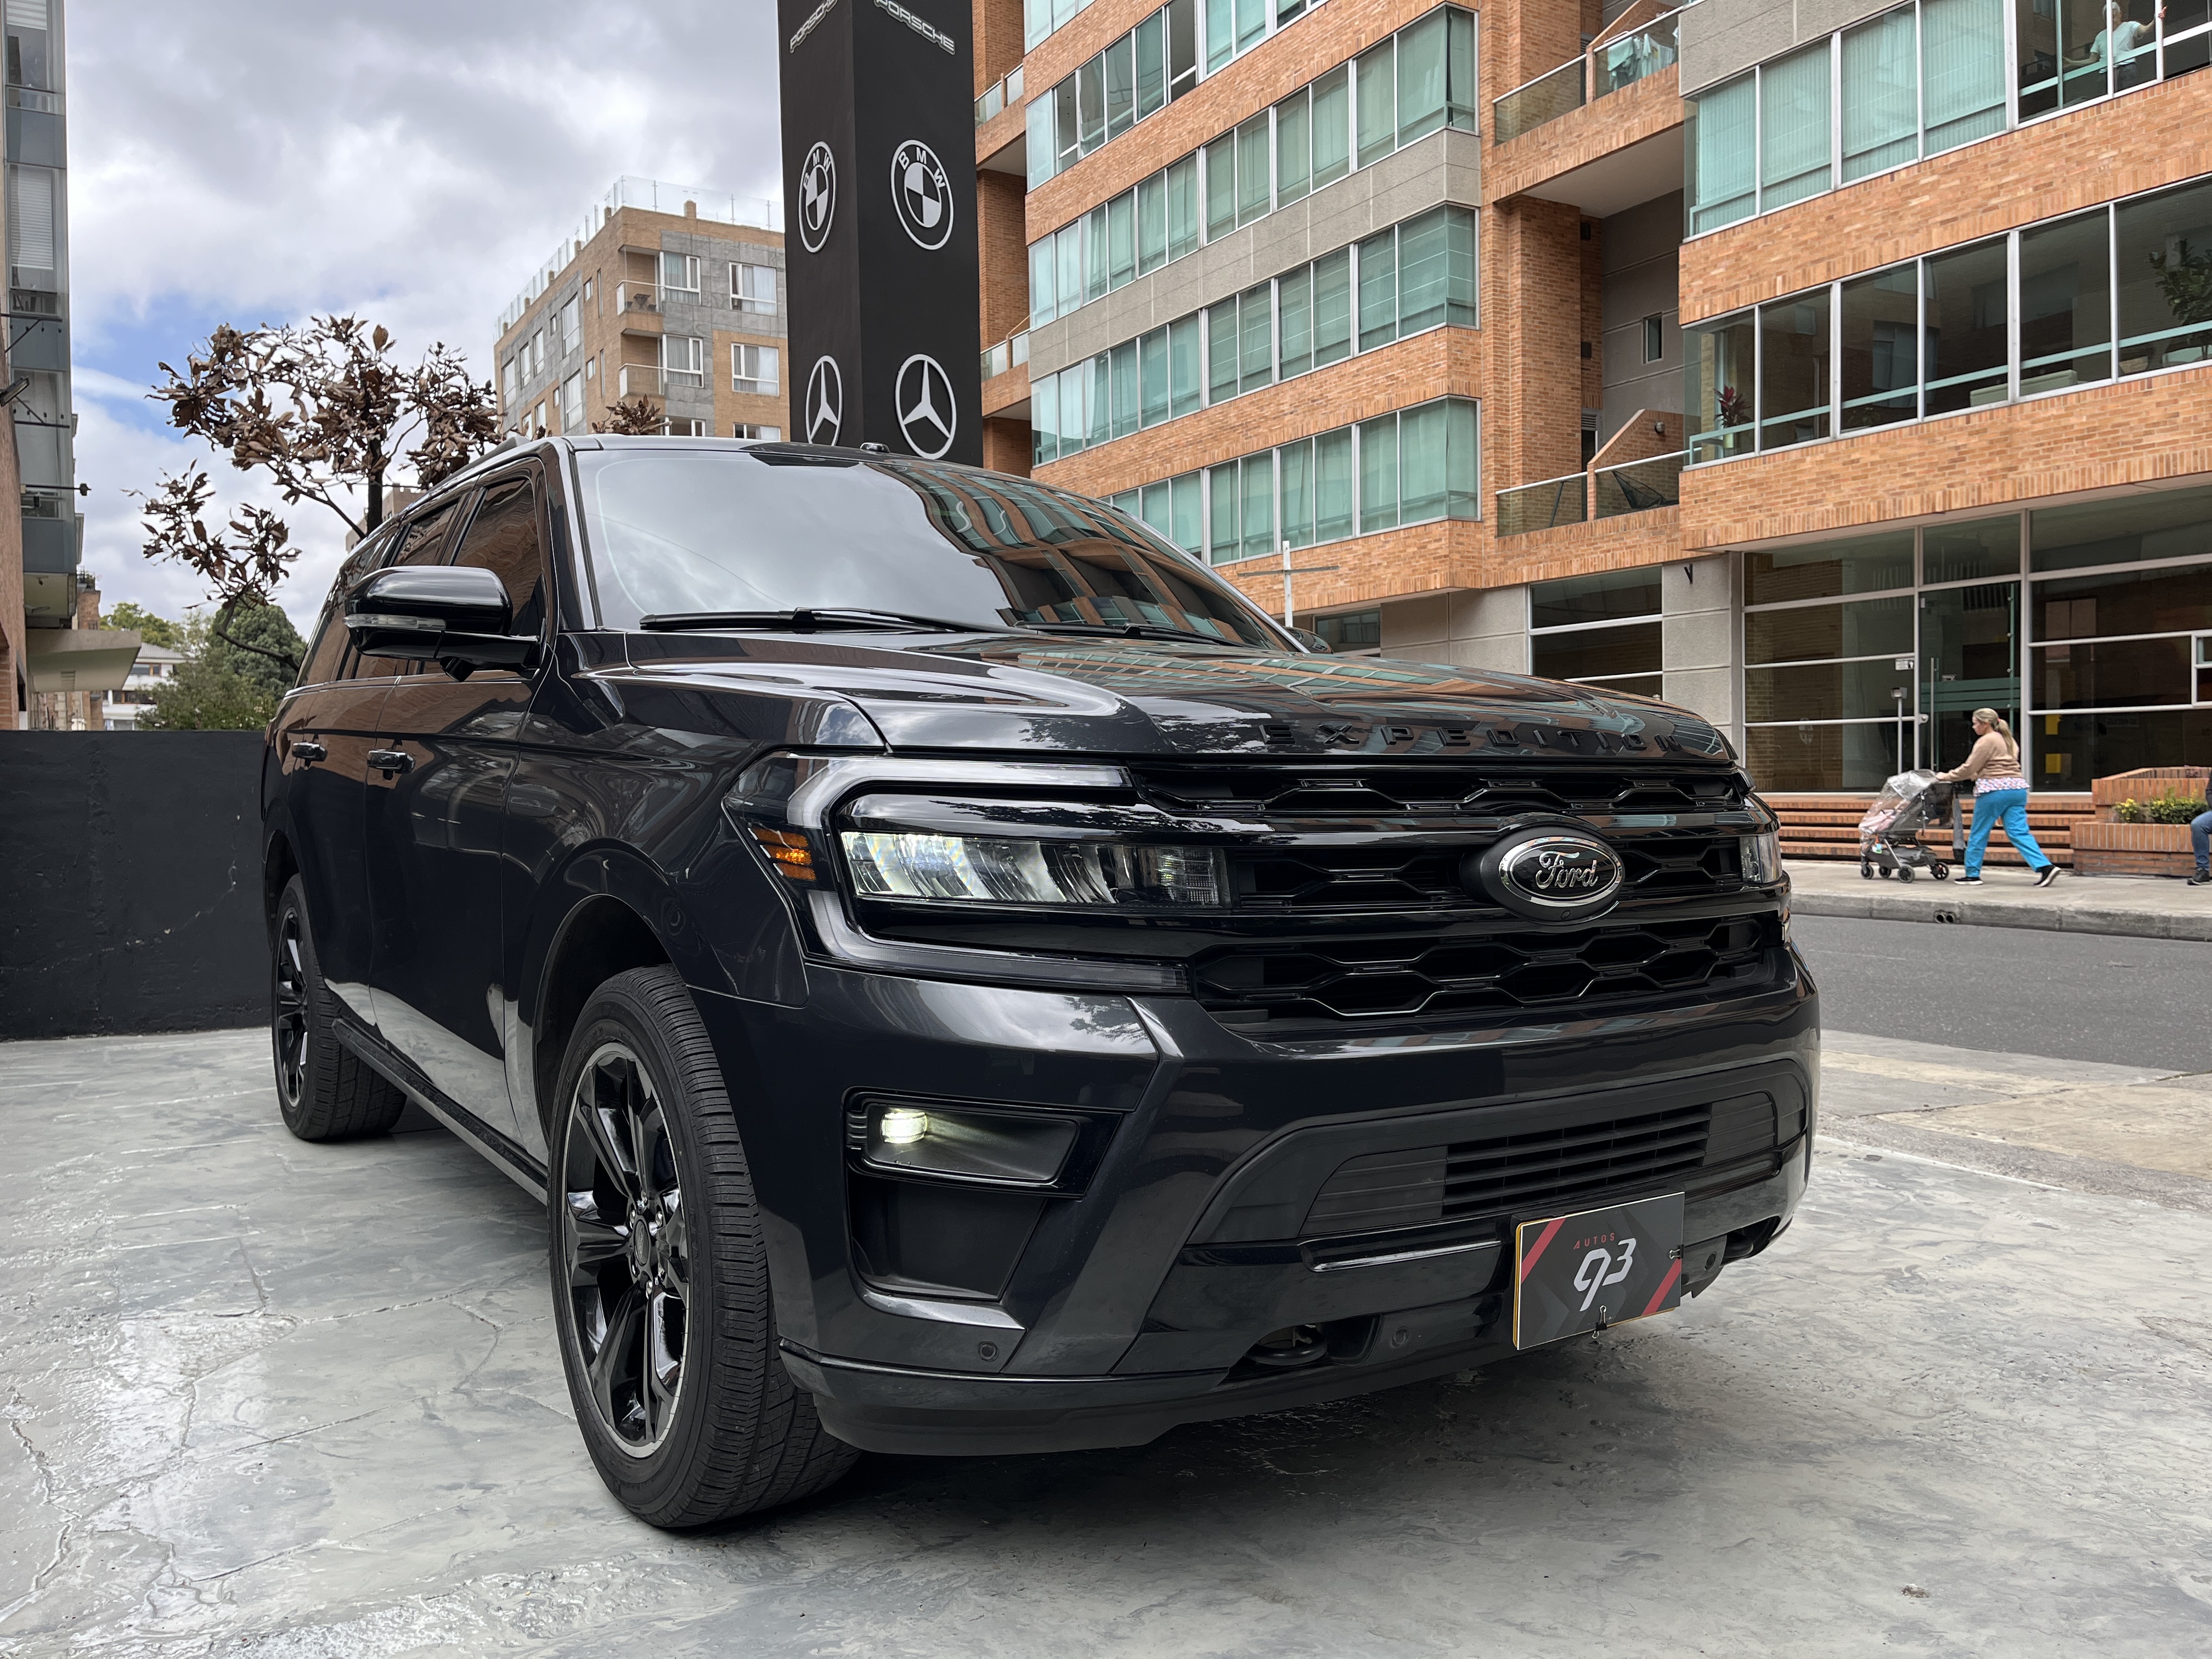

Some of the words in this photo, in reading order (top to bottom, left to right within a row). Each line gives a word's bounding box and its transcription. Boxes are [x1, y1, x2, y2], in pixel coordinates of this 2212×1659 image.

[803, 149, 832, 190] BMW
[898, 146, 946, 189] BMW
[1259, 723, 1682, 752] EXPEDITION
[1536, 851, 1599, 889] Ford
[1573, 1232, 1615, 1250] AUTOS
[1573, 1237, 1637, 1312] 93
